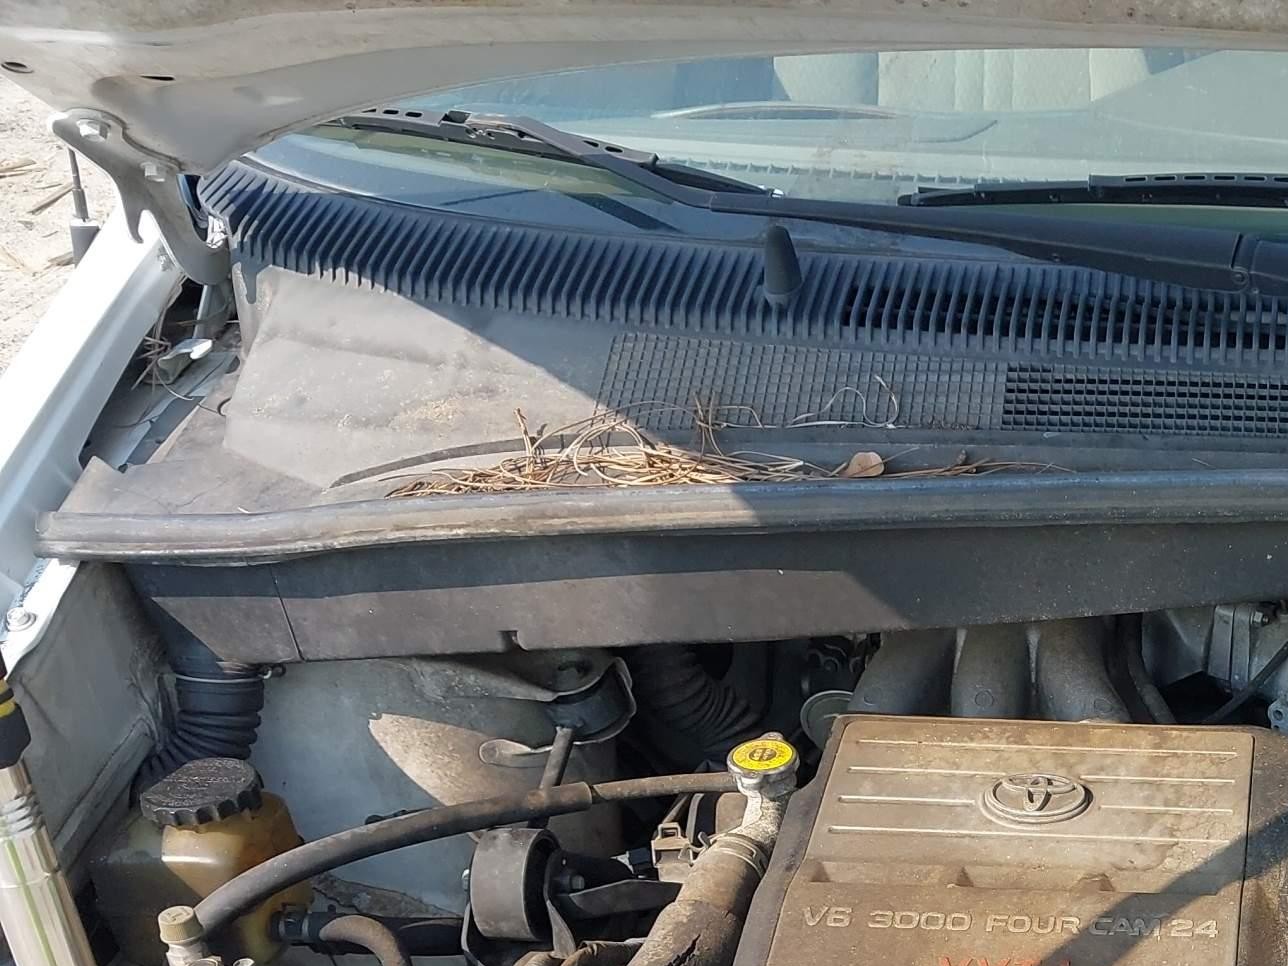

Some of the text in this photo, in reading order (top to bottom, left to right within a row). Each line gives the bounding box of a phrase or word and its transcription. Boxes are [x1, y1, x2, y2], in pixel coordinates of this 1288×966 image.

[801, 906, 1220, 939] V6 3000 FOUR CAM 24
